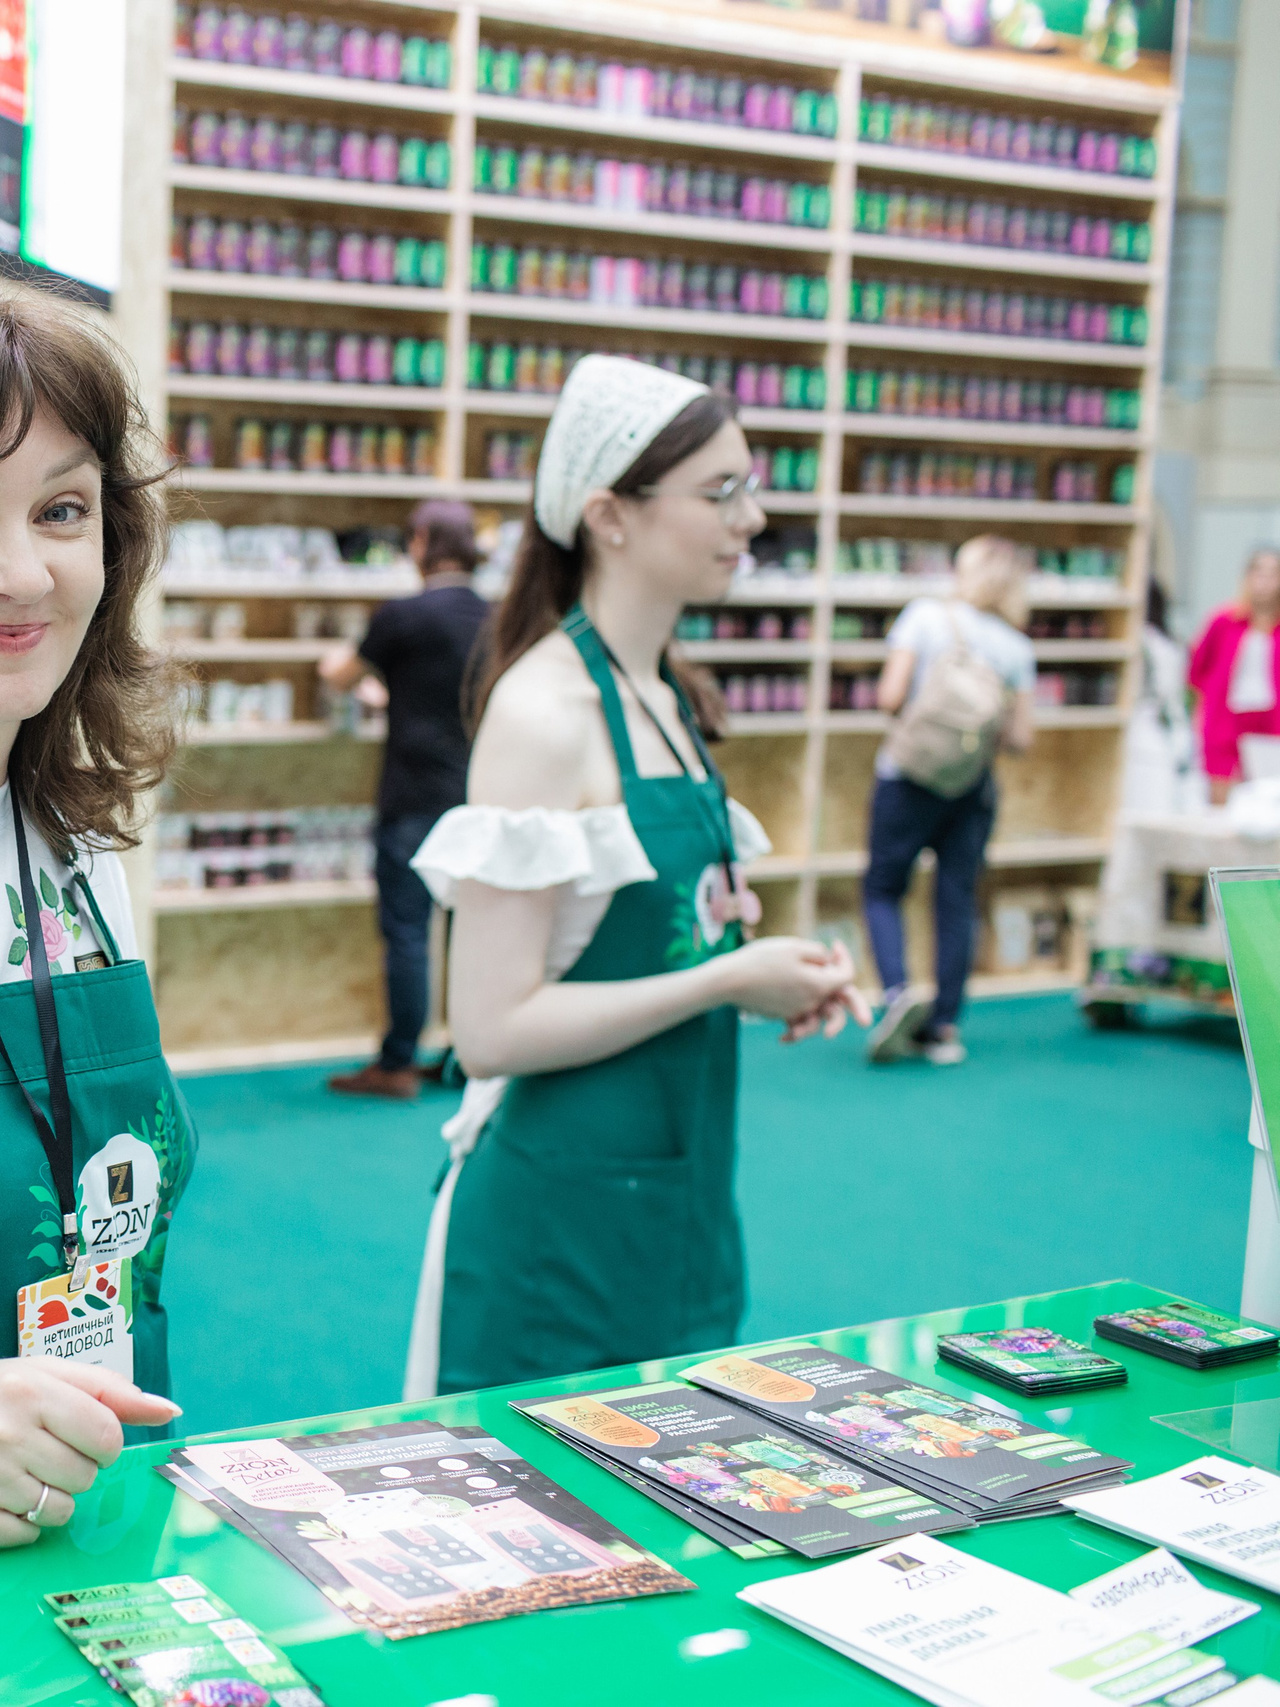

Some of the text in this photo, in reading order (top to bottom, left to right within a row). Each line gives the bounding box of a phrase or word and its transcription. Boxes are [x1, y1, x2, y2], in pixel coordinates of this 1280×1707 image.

[109, 1164, 130, 1205] Z
[617, 1401, 660, 1413] ЦИОН
[631, 1403, 688, 1419] ПРОТЕКТ
[639, 1409, 698, 1423] ИДЕАЛЬНОЕ
[649, 1416, 696, 1428] РЕШЕНИЕ
[303, 1448, 337, 1459] ЦИОН
[310, 1440, 452, 1465] УСТАВШИЙ ГРУНТ ПИТАЕТ,
[319, 1447, 449, 1470] ЗАГРЯЗНЕНИЯ УДАЛЯЕТ!
[220, 1457, 290, 1474] ZION
[231, 1466, 301, 1486] Detox
[1199, 1478, 1266, 1505] ZION
[894, 1559, 967, 1591] ZION
[860, 1613, 923, 1638] УМНАЯ
[884, 1605, 1001, 1649] ПИТАТЕЛЬНАЯ
[909, 1628, 989, 1662] ДОБАВКА
